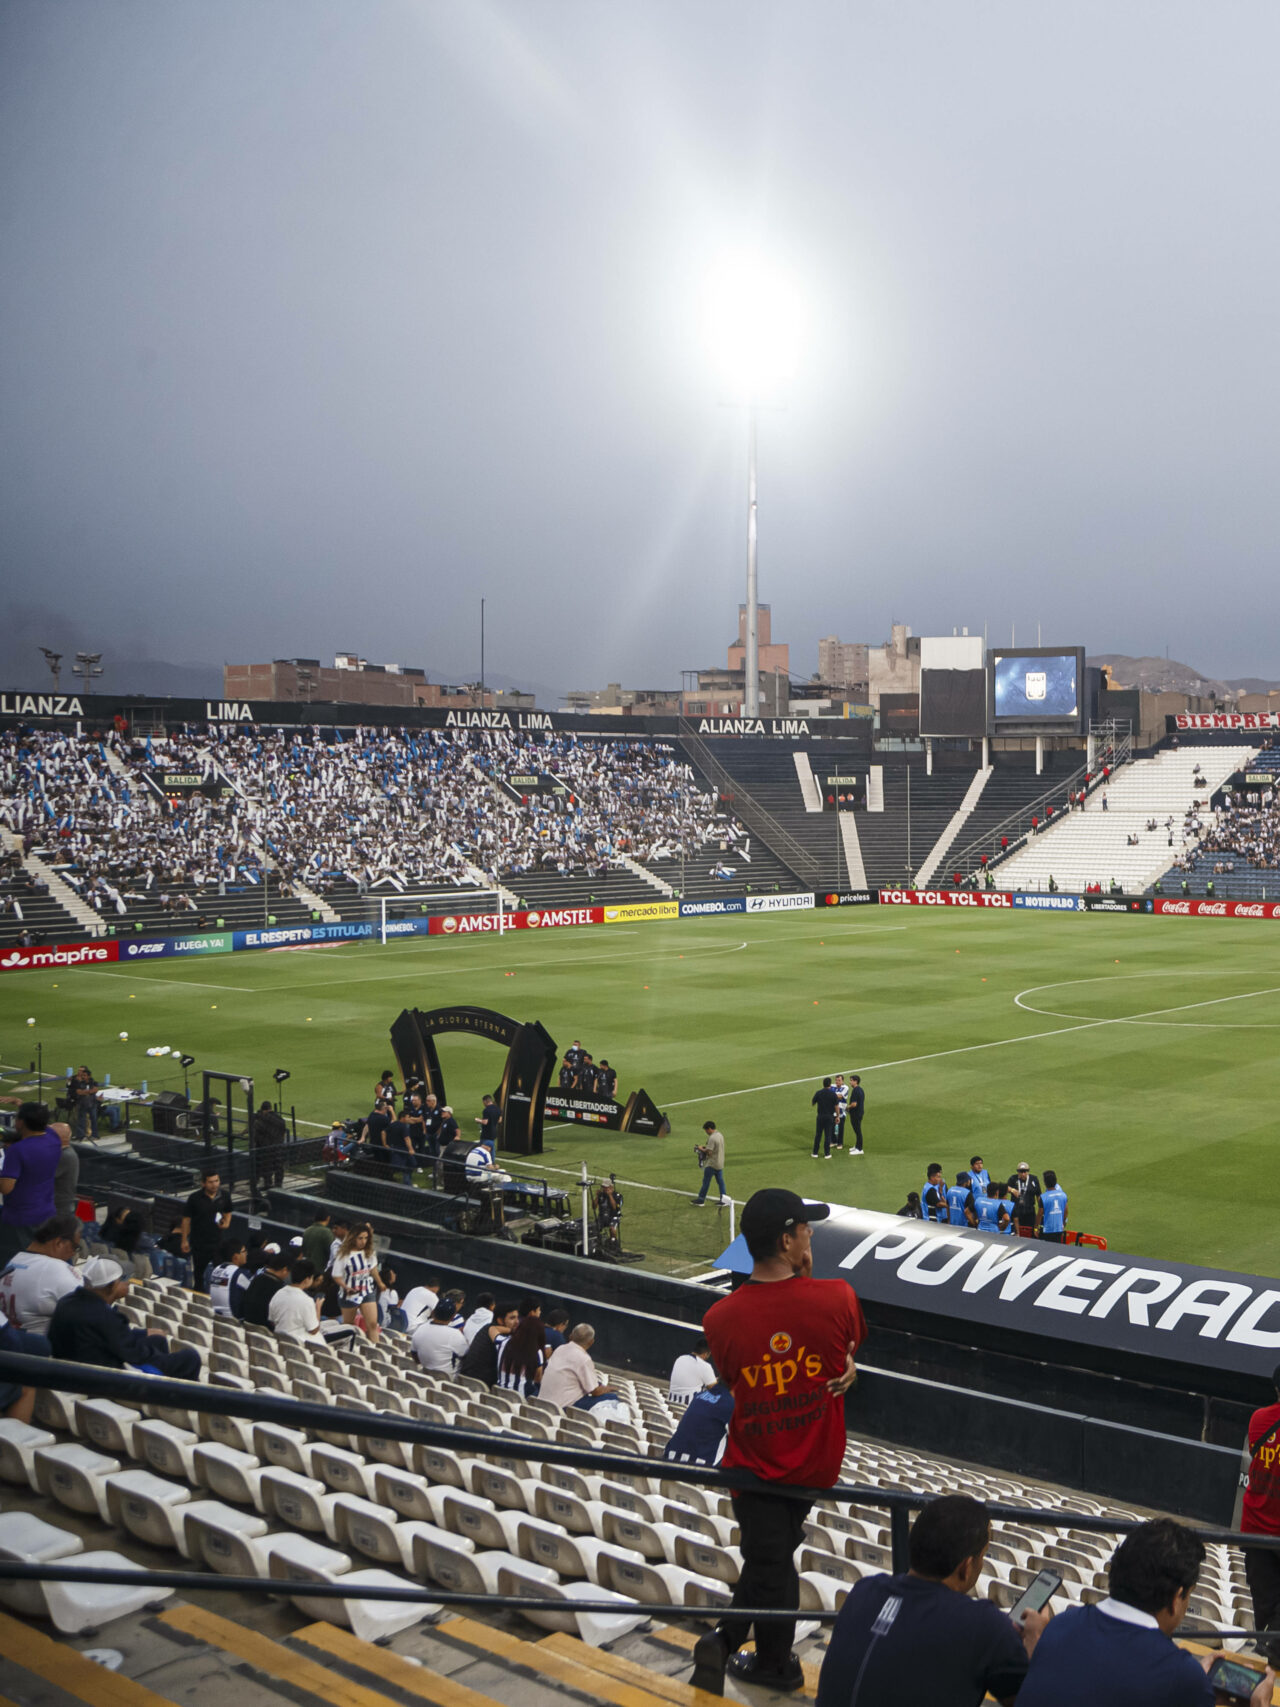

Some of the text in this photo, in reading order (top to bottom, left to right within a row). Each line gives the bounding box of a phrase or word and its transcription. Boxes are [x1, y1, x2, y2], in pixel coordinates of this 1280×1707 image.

[1, 695, 84, 716] LIANZA
[207, 702, 253, 721] LIMA
[446, 711, 553, 730] ALIANZA LIMA
[699, 719, 809, 735] ALIANZA LIMA
[1176, 713, 1273, 729] SIEMPRE
[167, 776, 199, 785] SALIDA
[829, 777, 854, 785] SALIDA
[1247, 775, 1270, 783] SALIDA
[769, 897, 812, 907] HYUNDAI
[840, 893, 870, 903] priceless
[881, 891, 911, 904] TCL
[915, 892, 945, 905] TCL
[949, 893, 978, 906] TCL
[982, 894, 1011, 907] TCL
[620, 902, 677, 917] mercado libre
[1162, 901, 1191, 914] Coca-Cola
[1198, 903, 1227, 915] Coca-Cola
[1235, 904, 1264, 916] Coca-Cola
[458, 915, 516, 932] AMSTEL
[541, 910, 593, 926] AMSTEL
[246, 933, 260, 945] EL
[312, 928, 326, 939] ES
[327, 924, 372, 937] TITULAR
[210, 939, 224, 948] YA!
[32, 948, 108, 965] mapfre
[569, 1100, 617, 1114] LIBERTADORES
[741, 1346, 823, 1396] vip's
